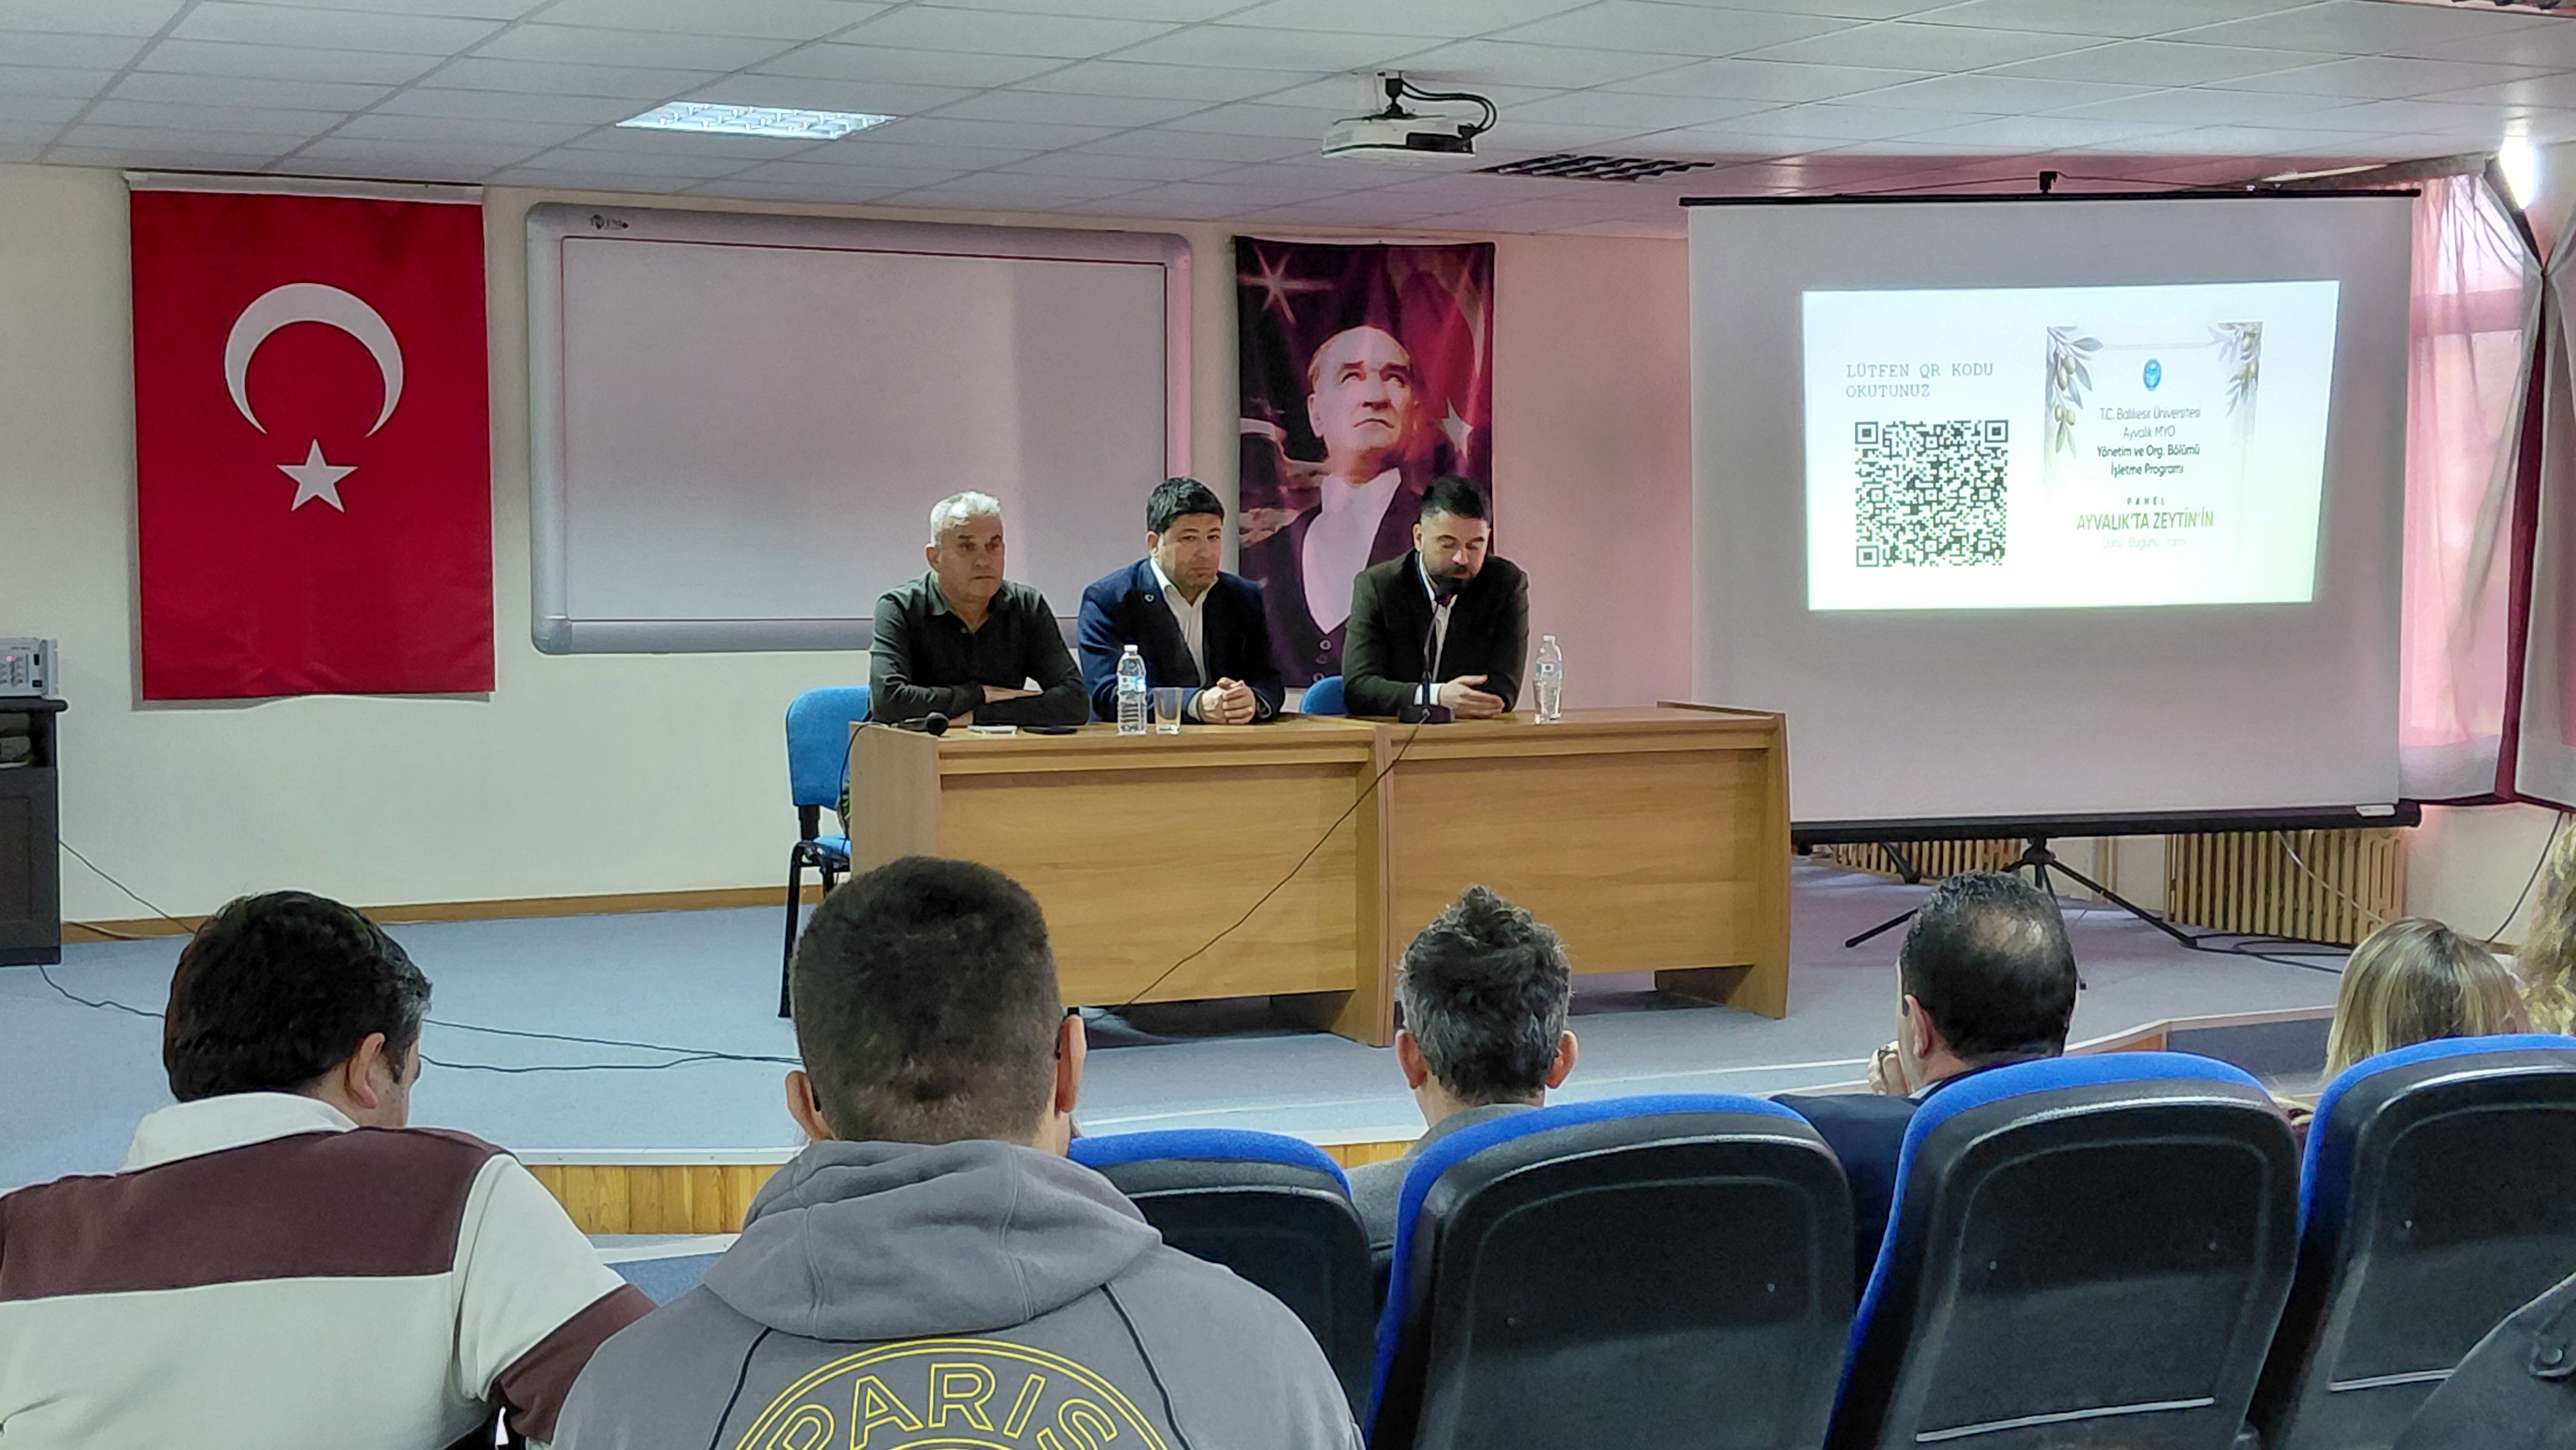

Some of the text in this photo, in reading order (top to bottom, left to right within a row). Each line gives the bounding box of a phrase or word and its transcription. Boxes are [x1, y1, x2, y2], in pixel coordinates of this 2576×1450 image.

[1846, 362, 1993, 379] LÜTFEN QR KODU
[1846, 384, 1930, 397] OKUTUNUZ
[2155, 425, 2176, 437] MYO
[2097, 445, 2132, 458] Yönetim
[2134, 447, 2144, 457] ve
[2077, 506, 2214, 530] AYVALIK'TA ZEYTİN'İN
